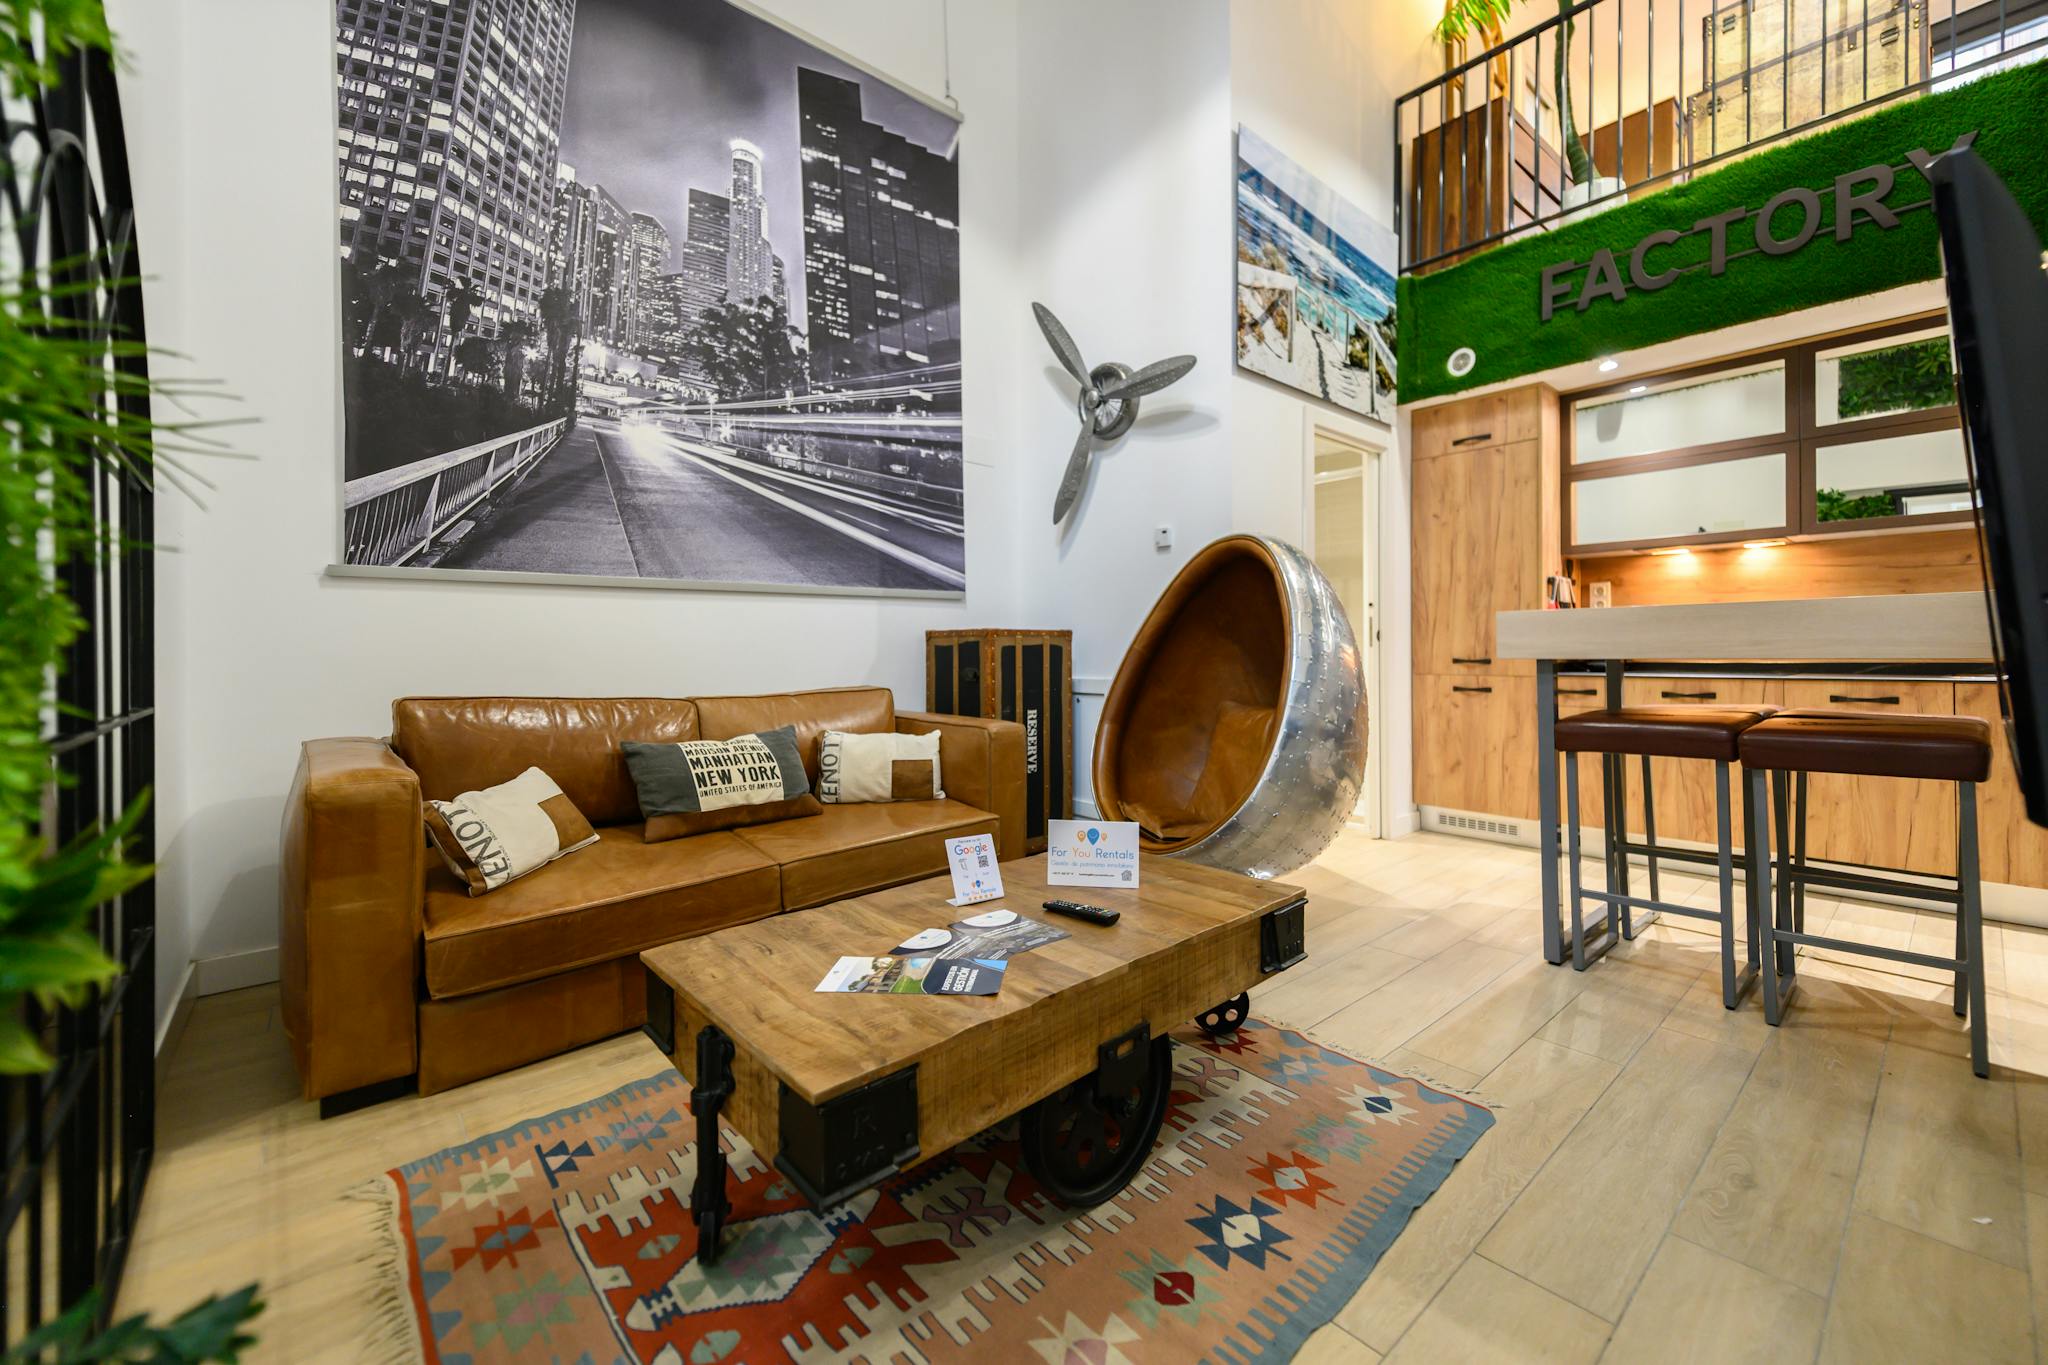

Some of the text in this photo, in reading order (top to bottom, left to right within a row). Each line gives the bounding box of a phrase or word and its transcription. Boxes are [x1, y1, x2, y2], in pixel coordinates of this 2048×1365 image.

[684, 744, 768, 757] MADISON AVENUE
[1027, 709, 1038, 774] RESERVE
[688, 751, 775, 770] MANHATTAN
[821, 734, 840, 803] ENOT
[694, 765, 780, 788] NEW YORK
[700, 781, 782, 798] UNITED STATES OF AMERICA
[436, 801, 511, 882] ENOT
[954, 843, 988, 855] Google
[1051, 846, 1135, 860] For You Rentals
